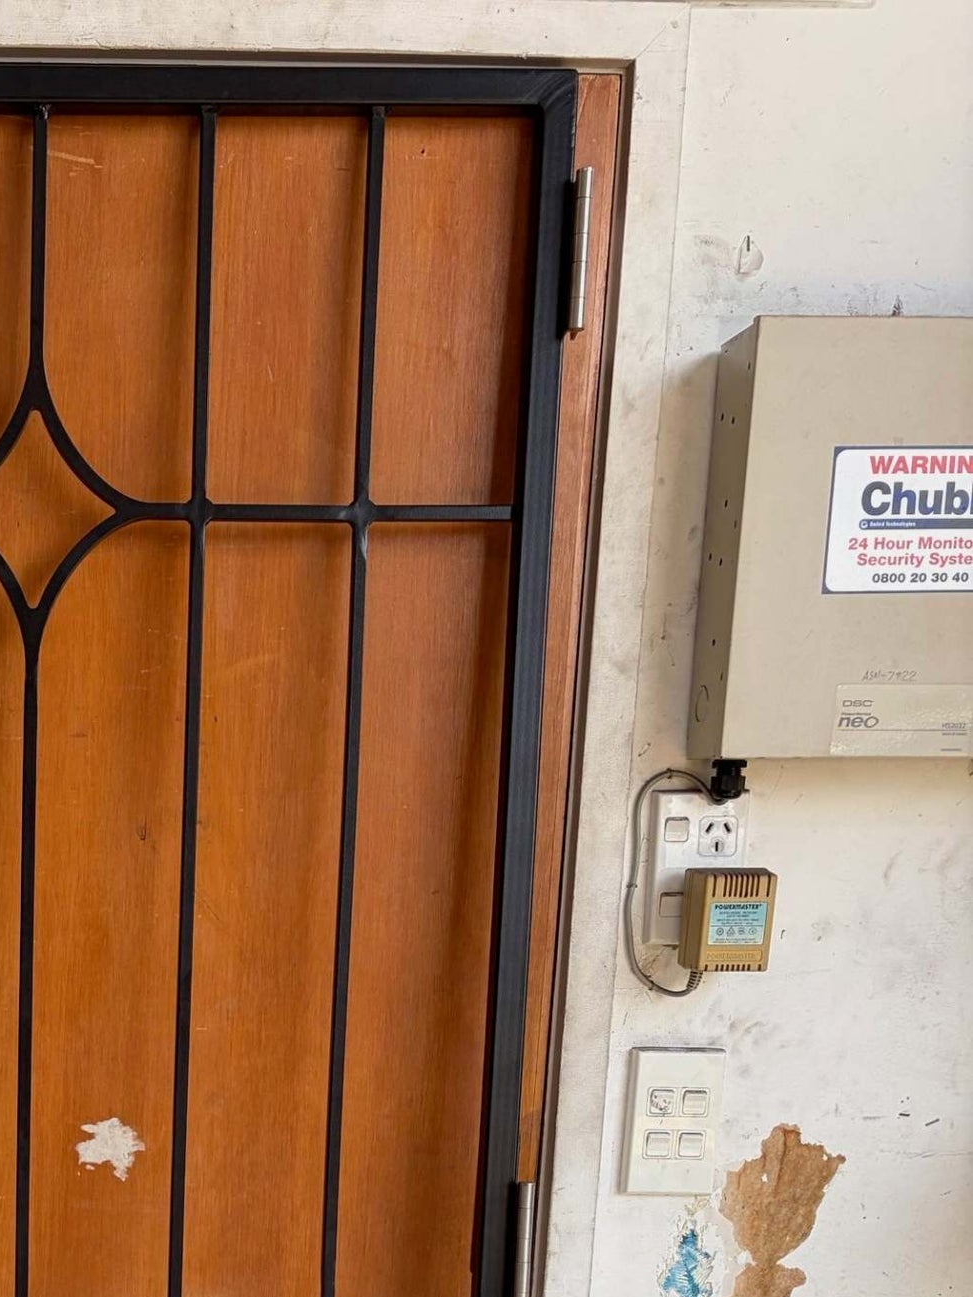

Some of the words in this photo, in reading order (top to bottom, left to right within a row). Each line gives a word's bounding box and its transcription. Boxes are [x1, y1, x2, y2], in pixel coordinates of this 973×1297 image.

[848, 537, 869, 550] 24
[873, 537, 913, 550] Hour
[857, 552, 924, 568] Security
[872, 573, 906, 583] 0800
[910, 573, 927, 583] 20
[931, 572, 948, 583] 30
[952, 572, 969, 583] 40
[837, 716, 879, 728] neo
